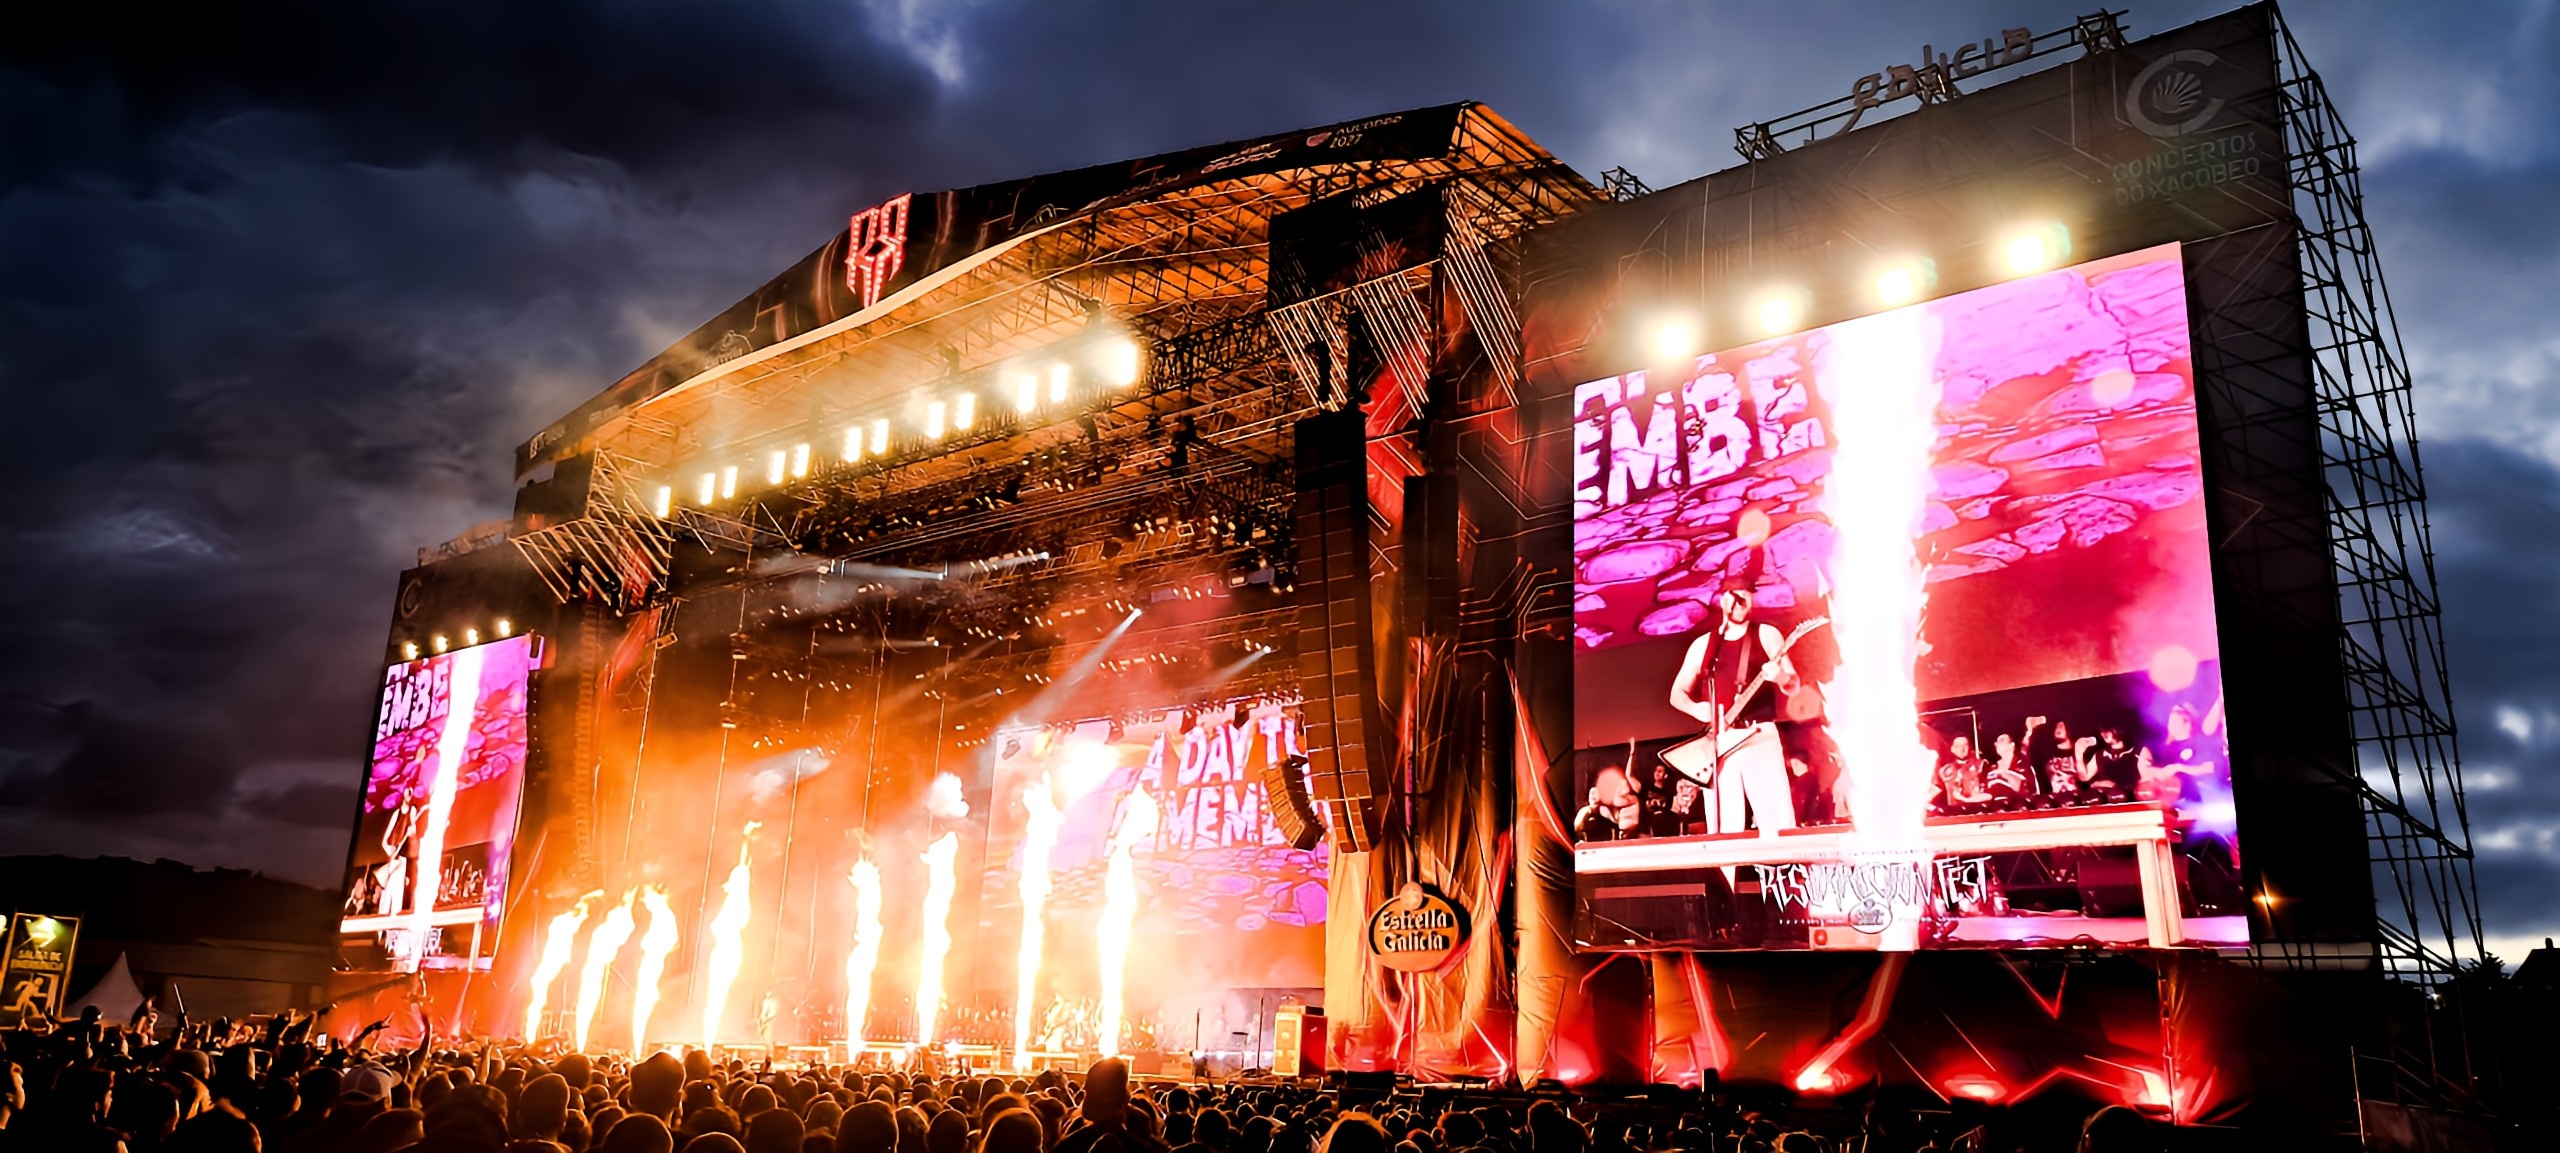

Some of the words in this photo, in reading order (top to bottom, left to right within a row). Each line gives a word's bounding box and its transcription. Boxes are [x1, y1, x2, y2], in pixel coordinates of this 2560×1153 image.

[2112, 131, 2257, 183] CONCERTOS
[2115, 183, 2145, 208] DO
[2151, 156, 2260, 199] XACOBEO
[1177, 721, 1248, 787] DAY
[1379, 908, 1447, 931] Estrella
[1384, 931, 1443, 952] Galicia
